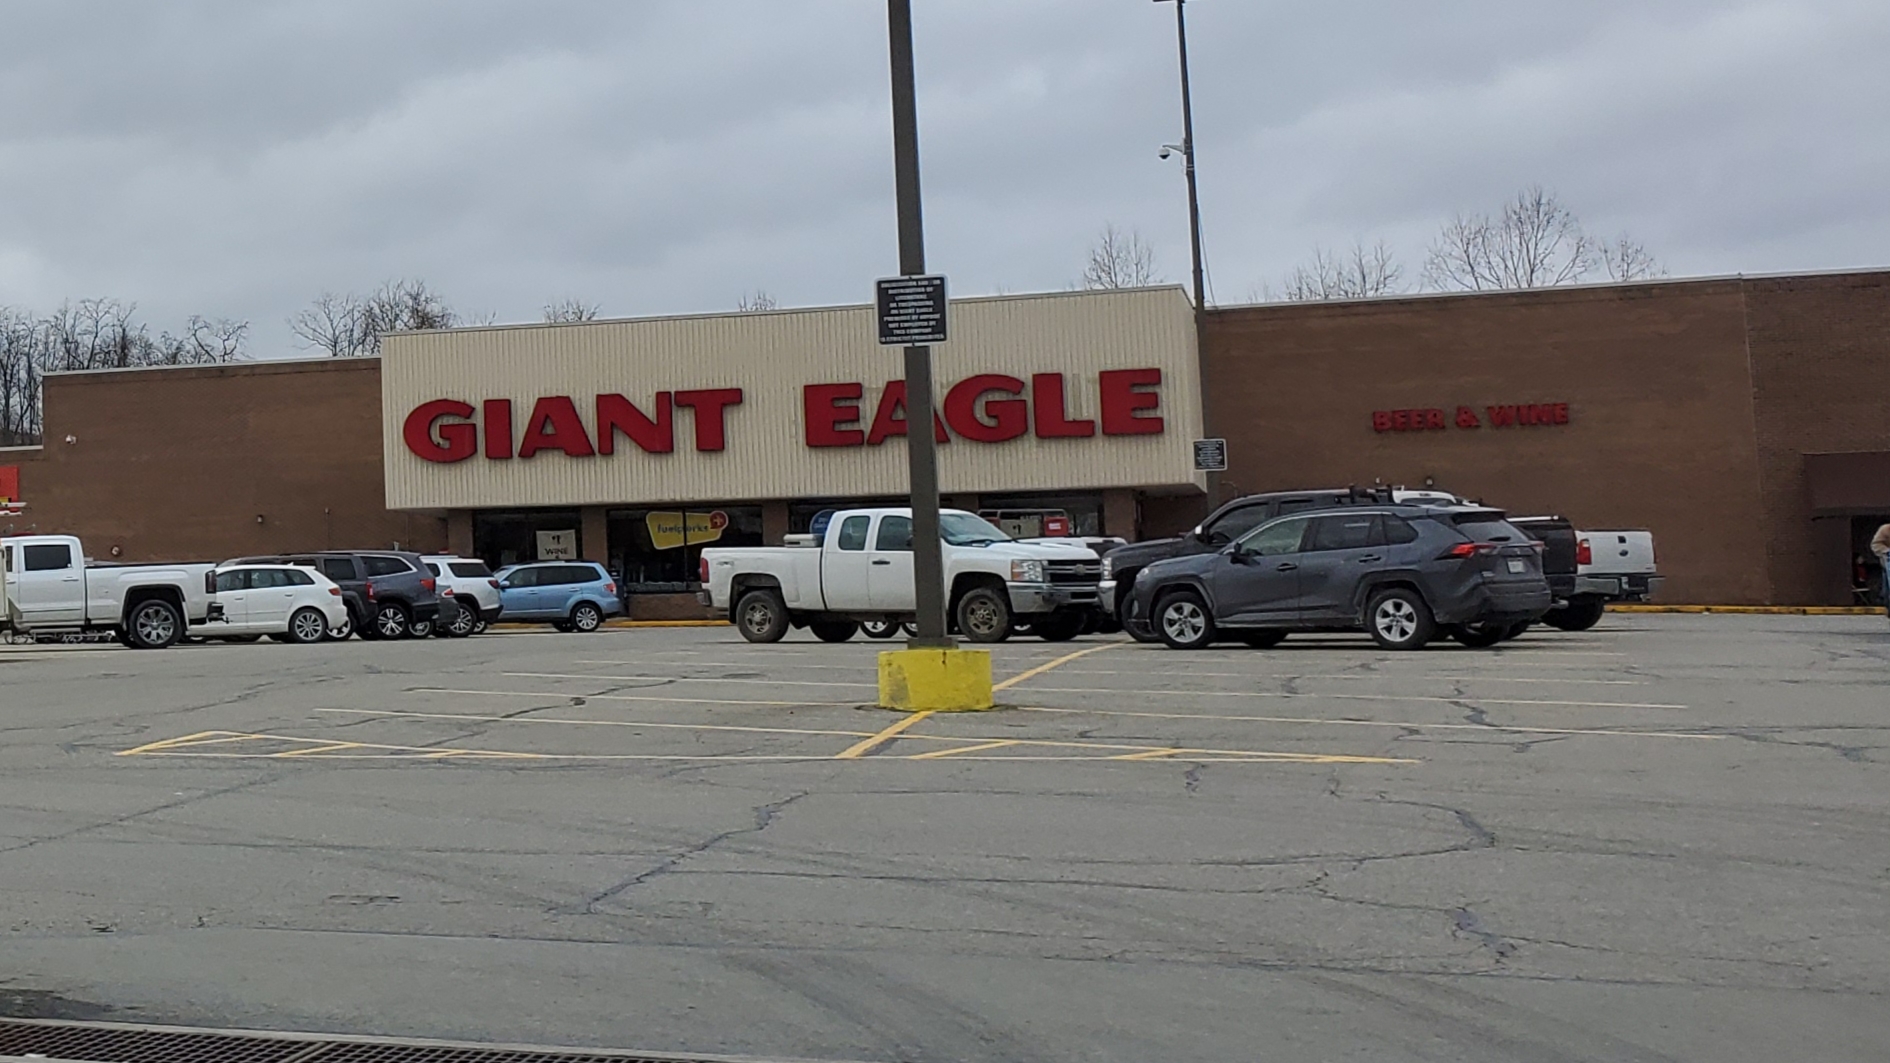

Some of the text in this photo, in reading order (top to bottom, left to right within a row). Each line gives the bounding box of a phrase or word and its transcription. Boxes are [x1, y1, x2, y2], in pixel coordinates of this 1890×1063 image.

[403, 367, 1165, 463] GIANT EAGLE
[1372, 402, 1569, 433] BEER & WINE
